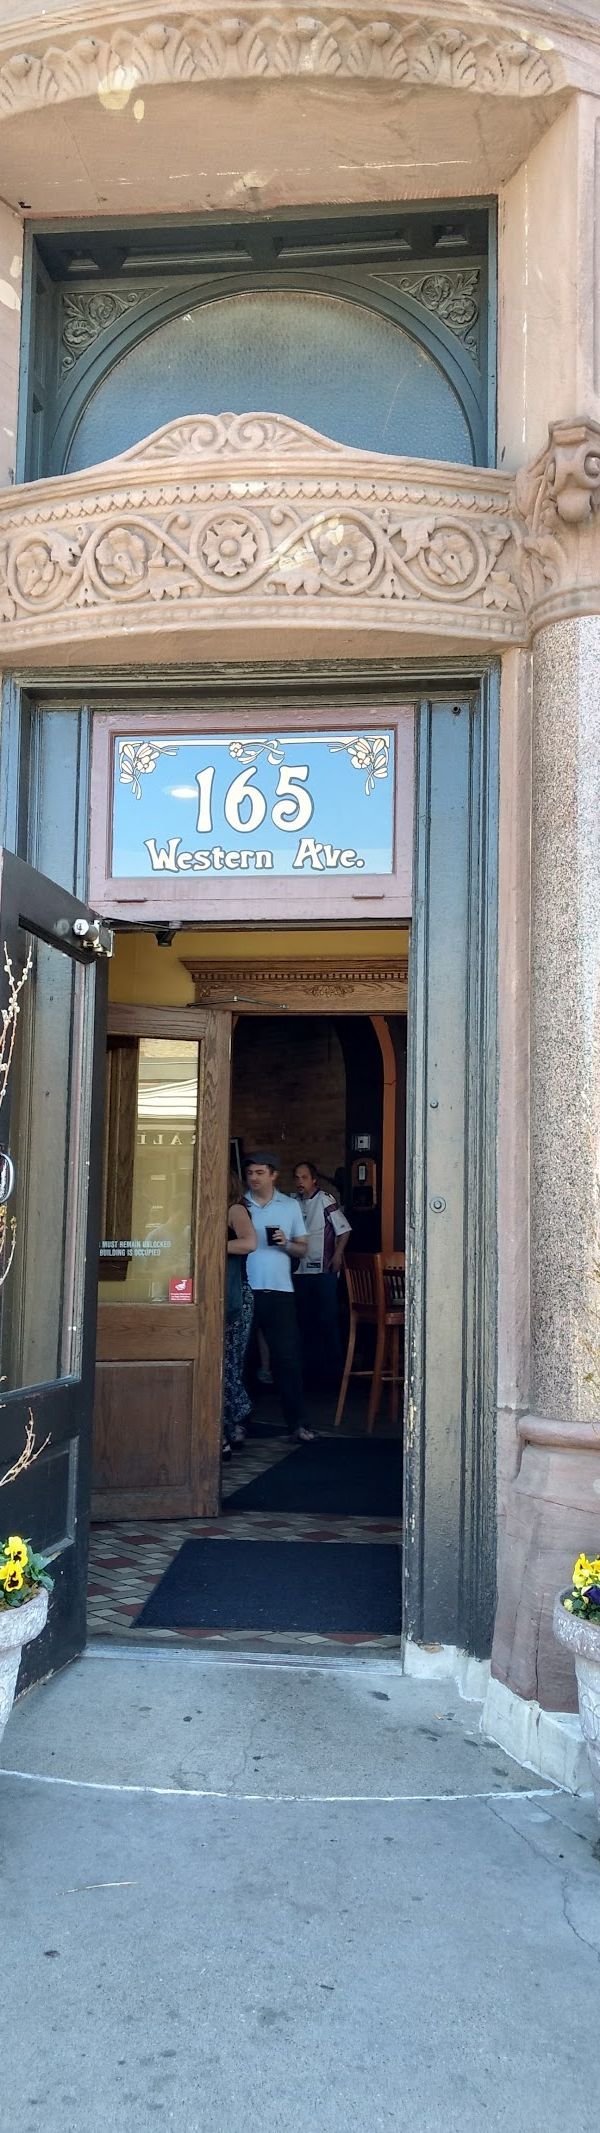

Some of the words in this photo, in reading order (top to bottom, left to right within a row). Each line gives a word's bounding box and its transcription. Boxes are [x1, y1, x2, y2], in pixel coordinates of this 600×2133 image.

[195, 765, 314, 834] 165
[143, 837, 275, 873] Western
[292, 837, 366, 871] Ave.
[99, 1248, 126, 1257] BUILDING
[127, 1248, 133, 1257] IS
[134, 1248, 161, 1257] OCCUPIED
[102, 1240, 118, 1248] MUST
[119, 1240, 141, 1248] REMAIN
[142, 1240, 172, 1248] UNLOCKED
